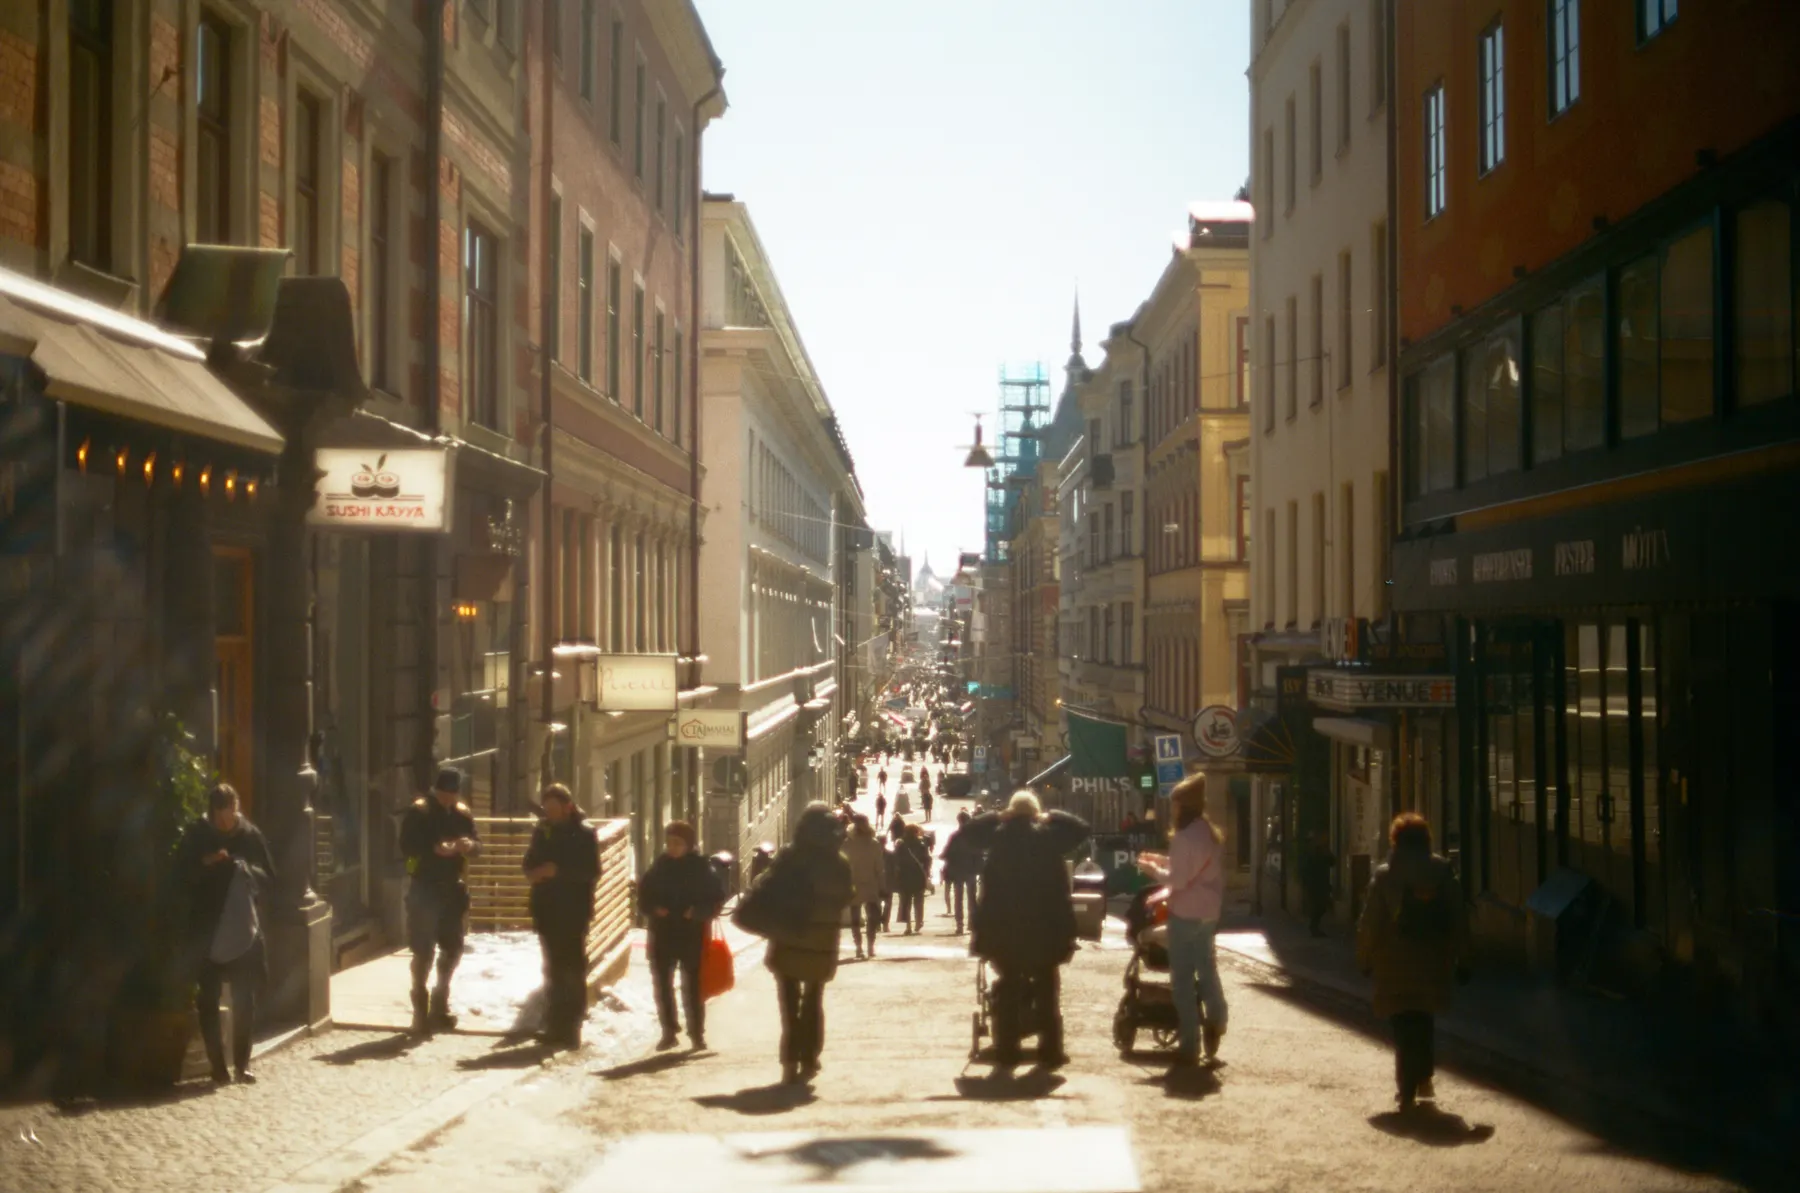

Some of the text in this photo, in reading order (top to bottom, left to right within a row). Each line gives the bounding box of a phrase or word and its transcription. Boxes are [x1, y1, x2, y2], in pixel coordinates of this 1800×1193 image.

[326, 505, 371, 517] SUSHI
[1358, 681, 1429, 702] VENUE
[1071, 776, 1133, 793] PHIL'S
